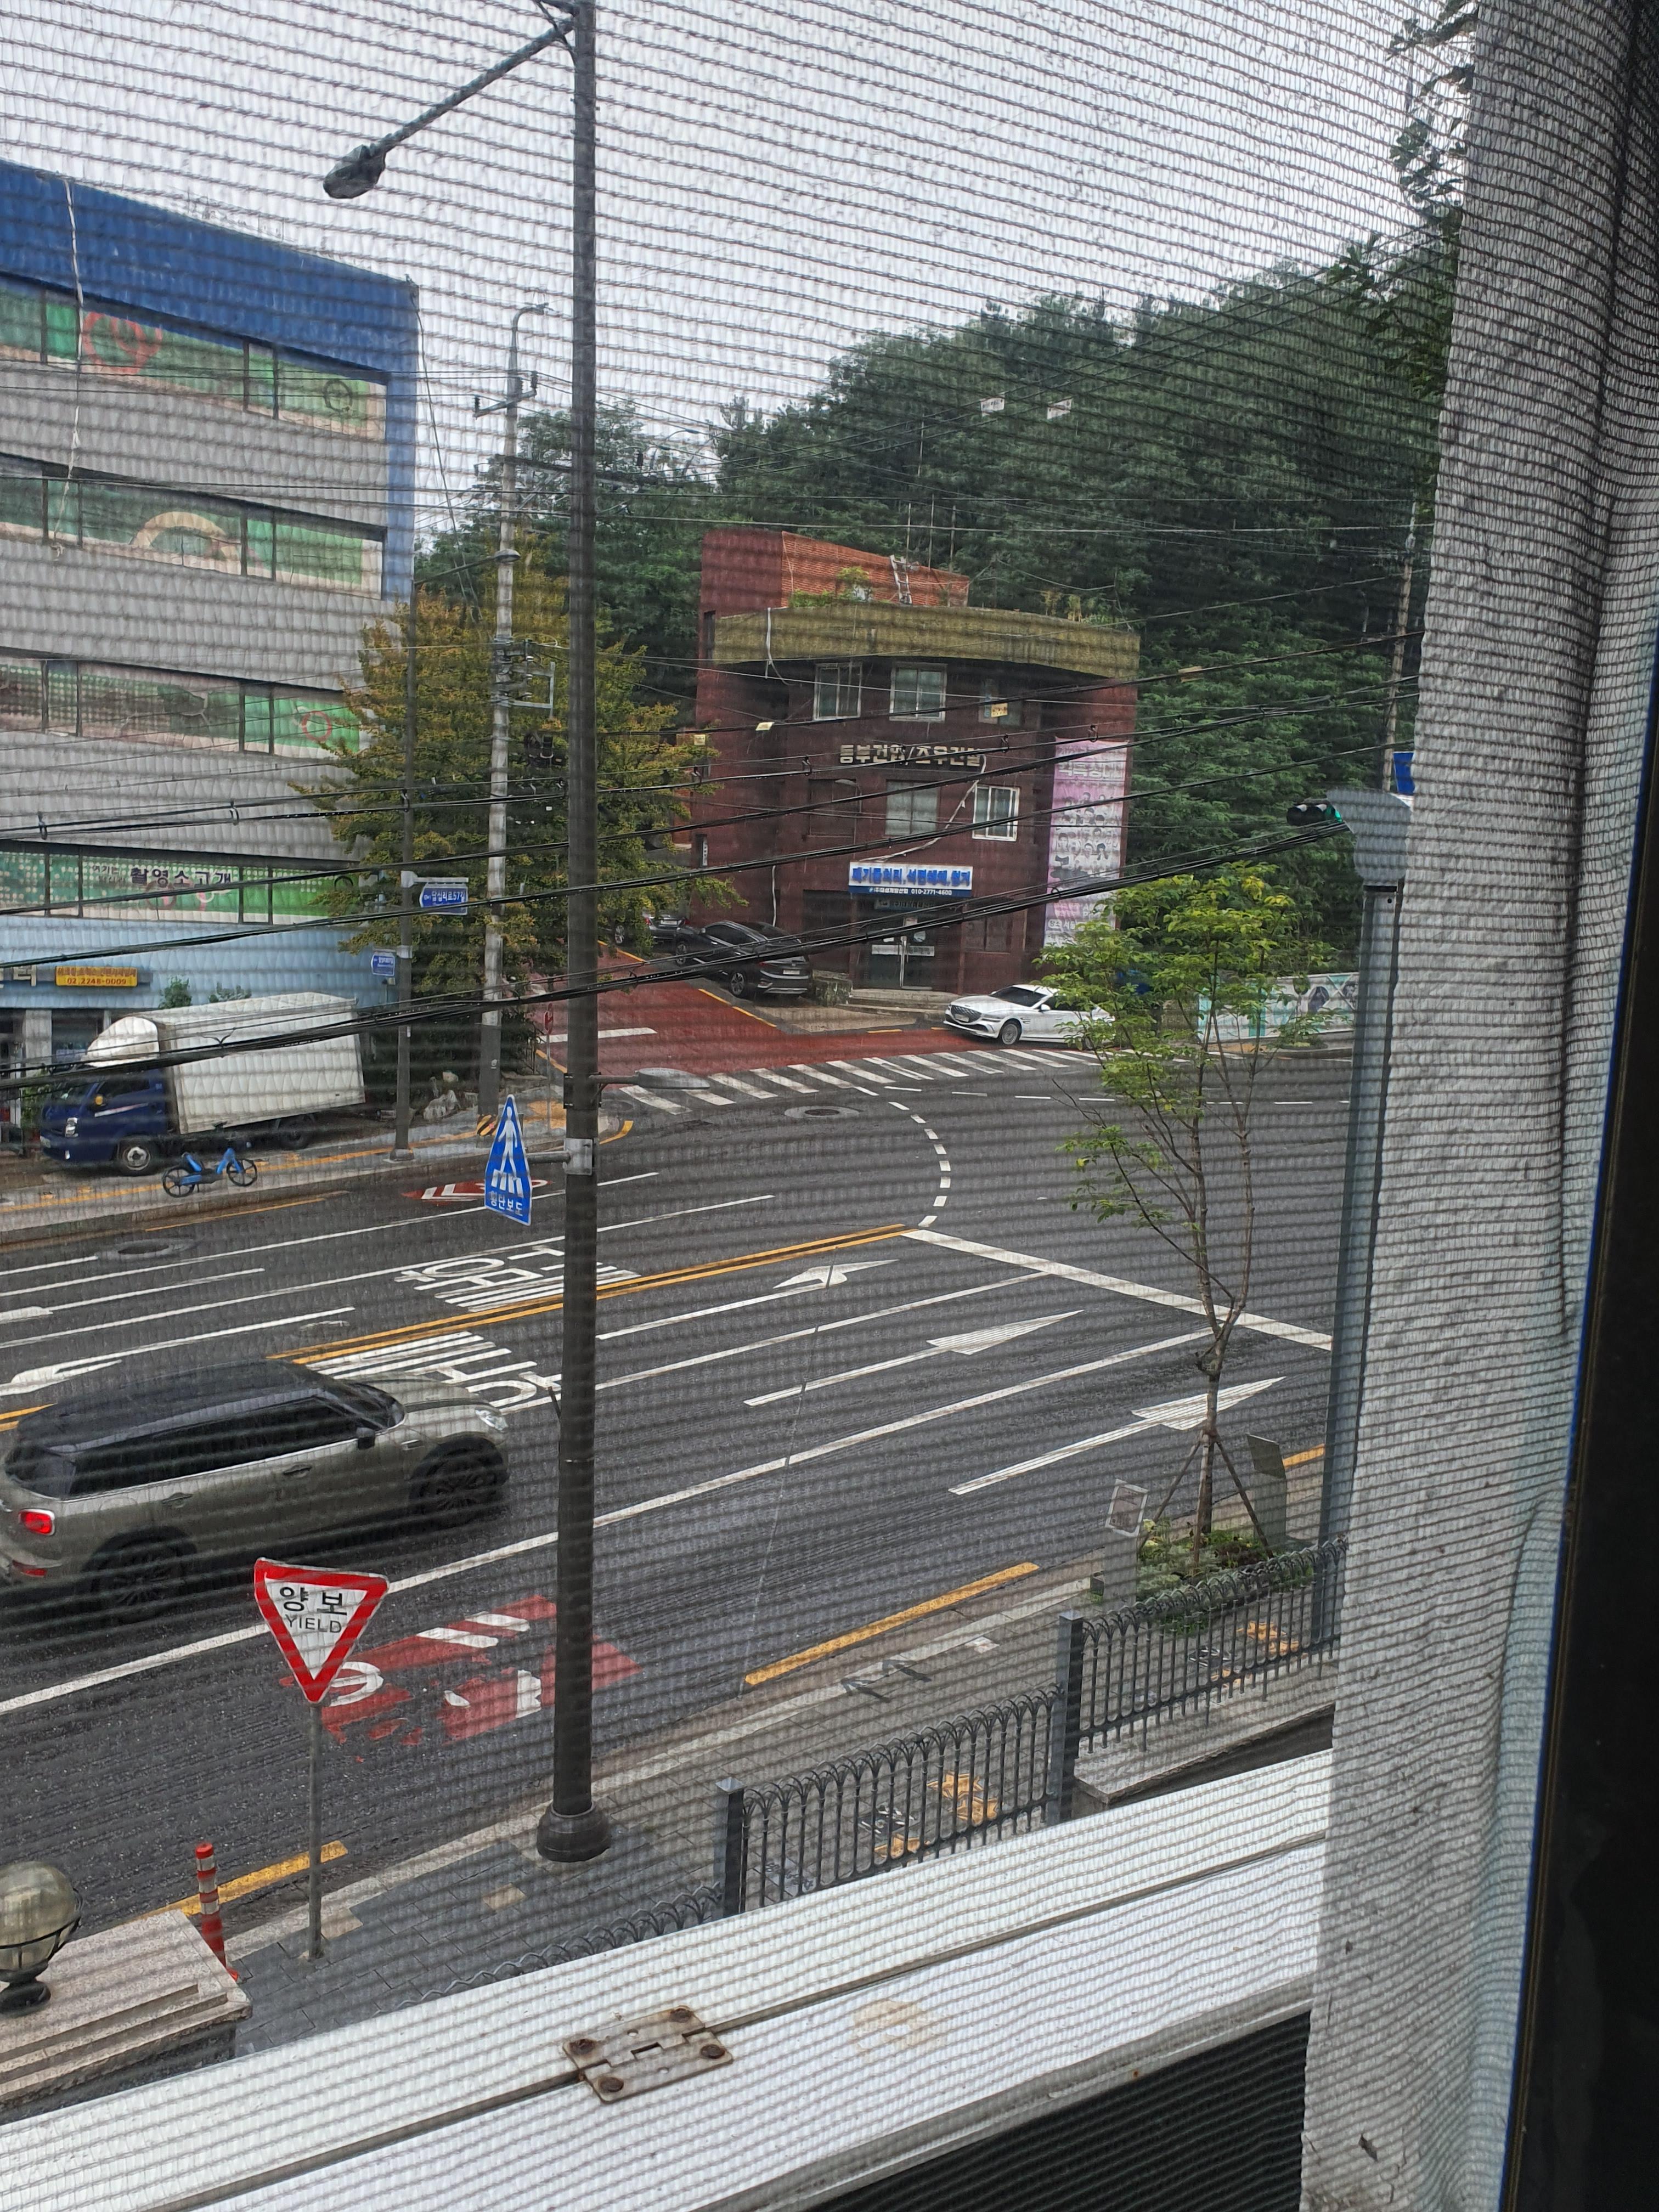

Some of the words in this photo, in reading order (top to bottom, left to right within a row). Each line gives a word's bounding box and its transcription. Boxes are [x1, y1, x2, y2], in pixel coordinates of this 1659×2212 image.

[488, 1190, 524, 1216] 횡단보도
[279, 1587, 347, 1616] 양보
[285, 1614, 342, 1633] YIELD
